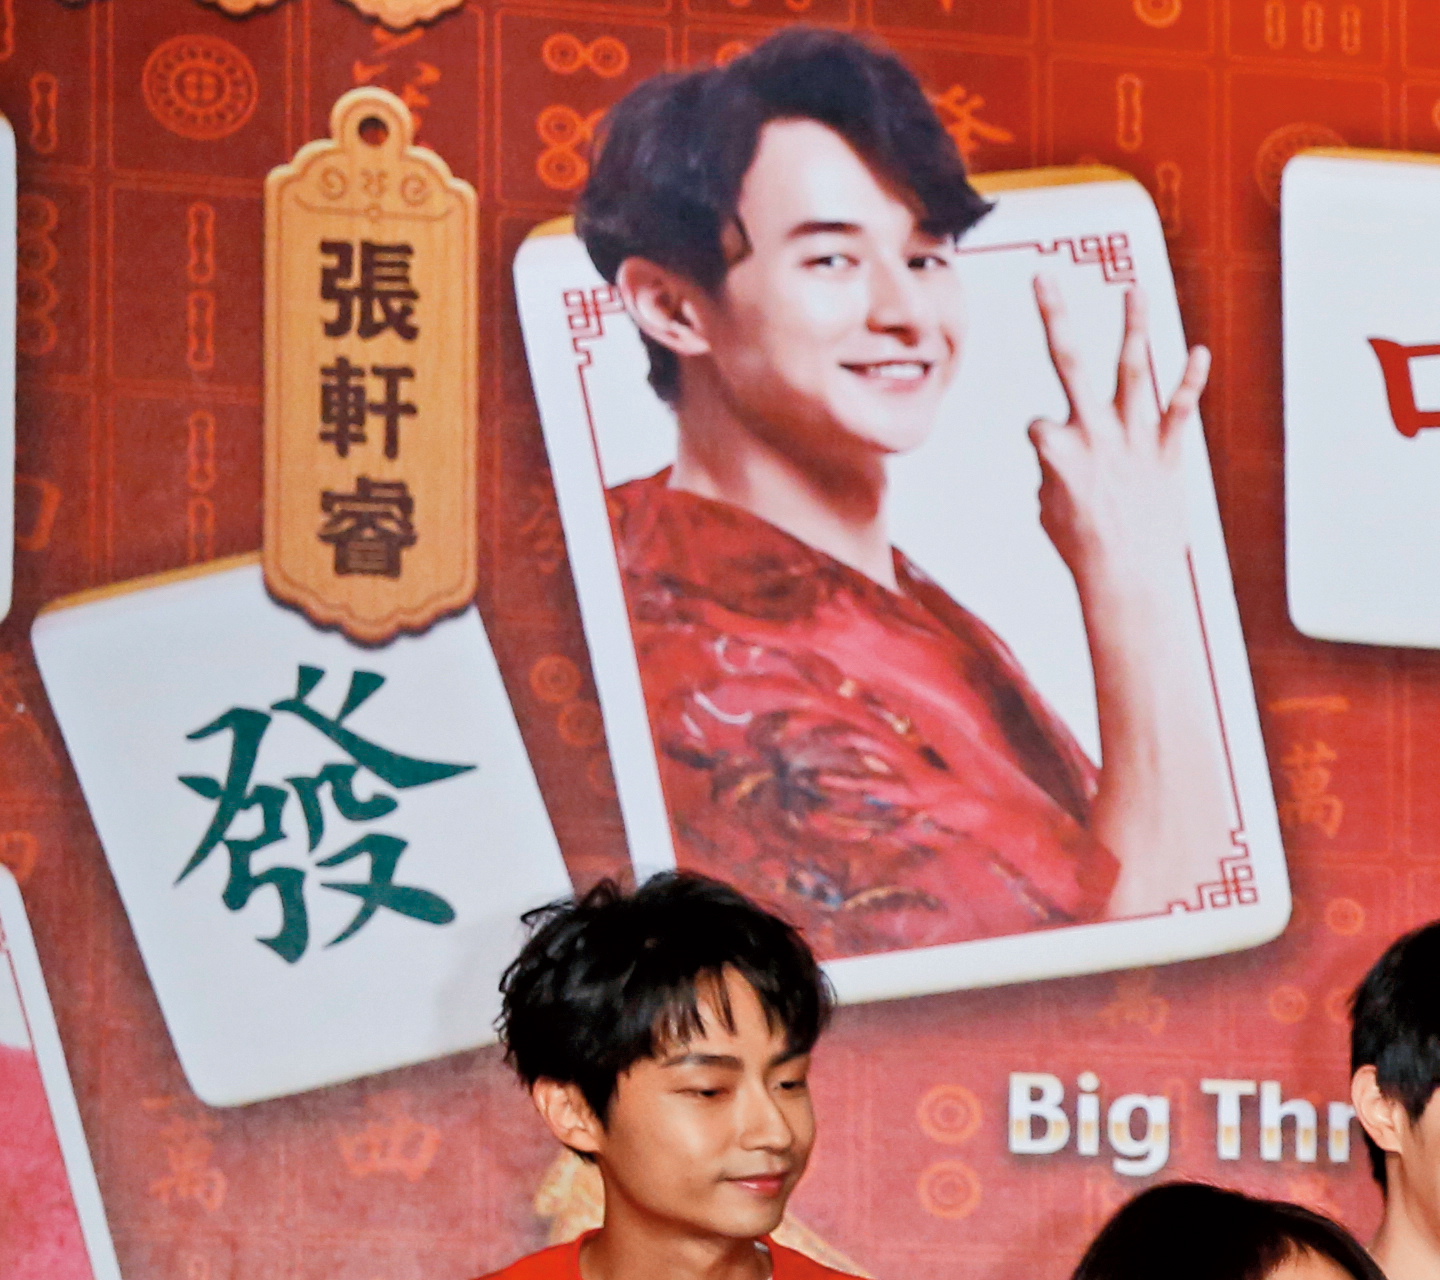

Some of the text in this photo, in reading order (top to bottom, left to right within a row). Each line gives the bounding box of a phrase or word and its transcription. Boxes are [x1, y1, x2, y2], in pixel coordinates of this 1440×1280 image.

[319, 240, 420, 580] 張軒睿
[174, 664, 477, 964] 發
[1006, 1072, 1172, 1177] Big
[1201, 1078, 1364, 1162] Thr
